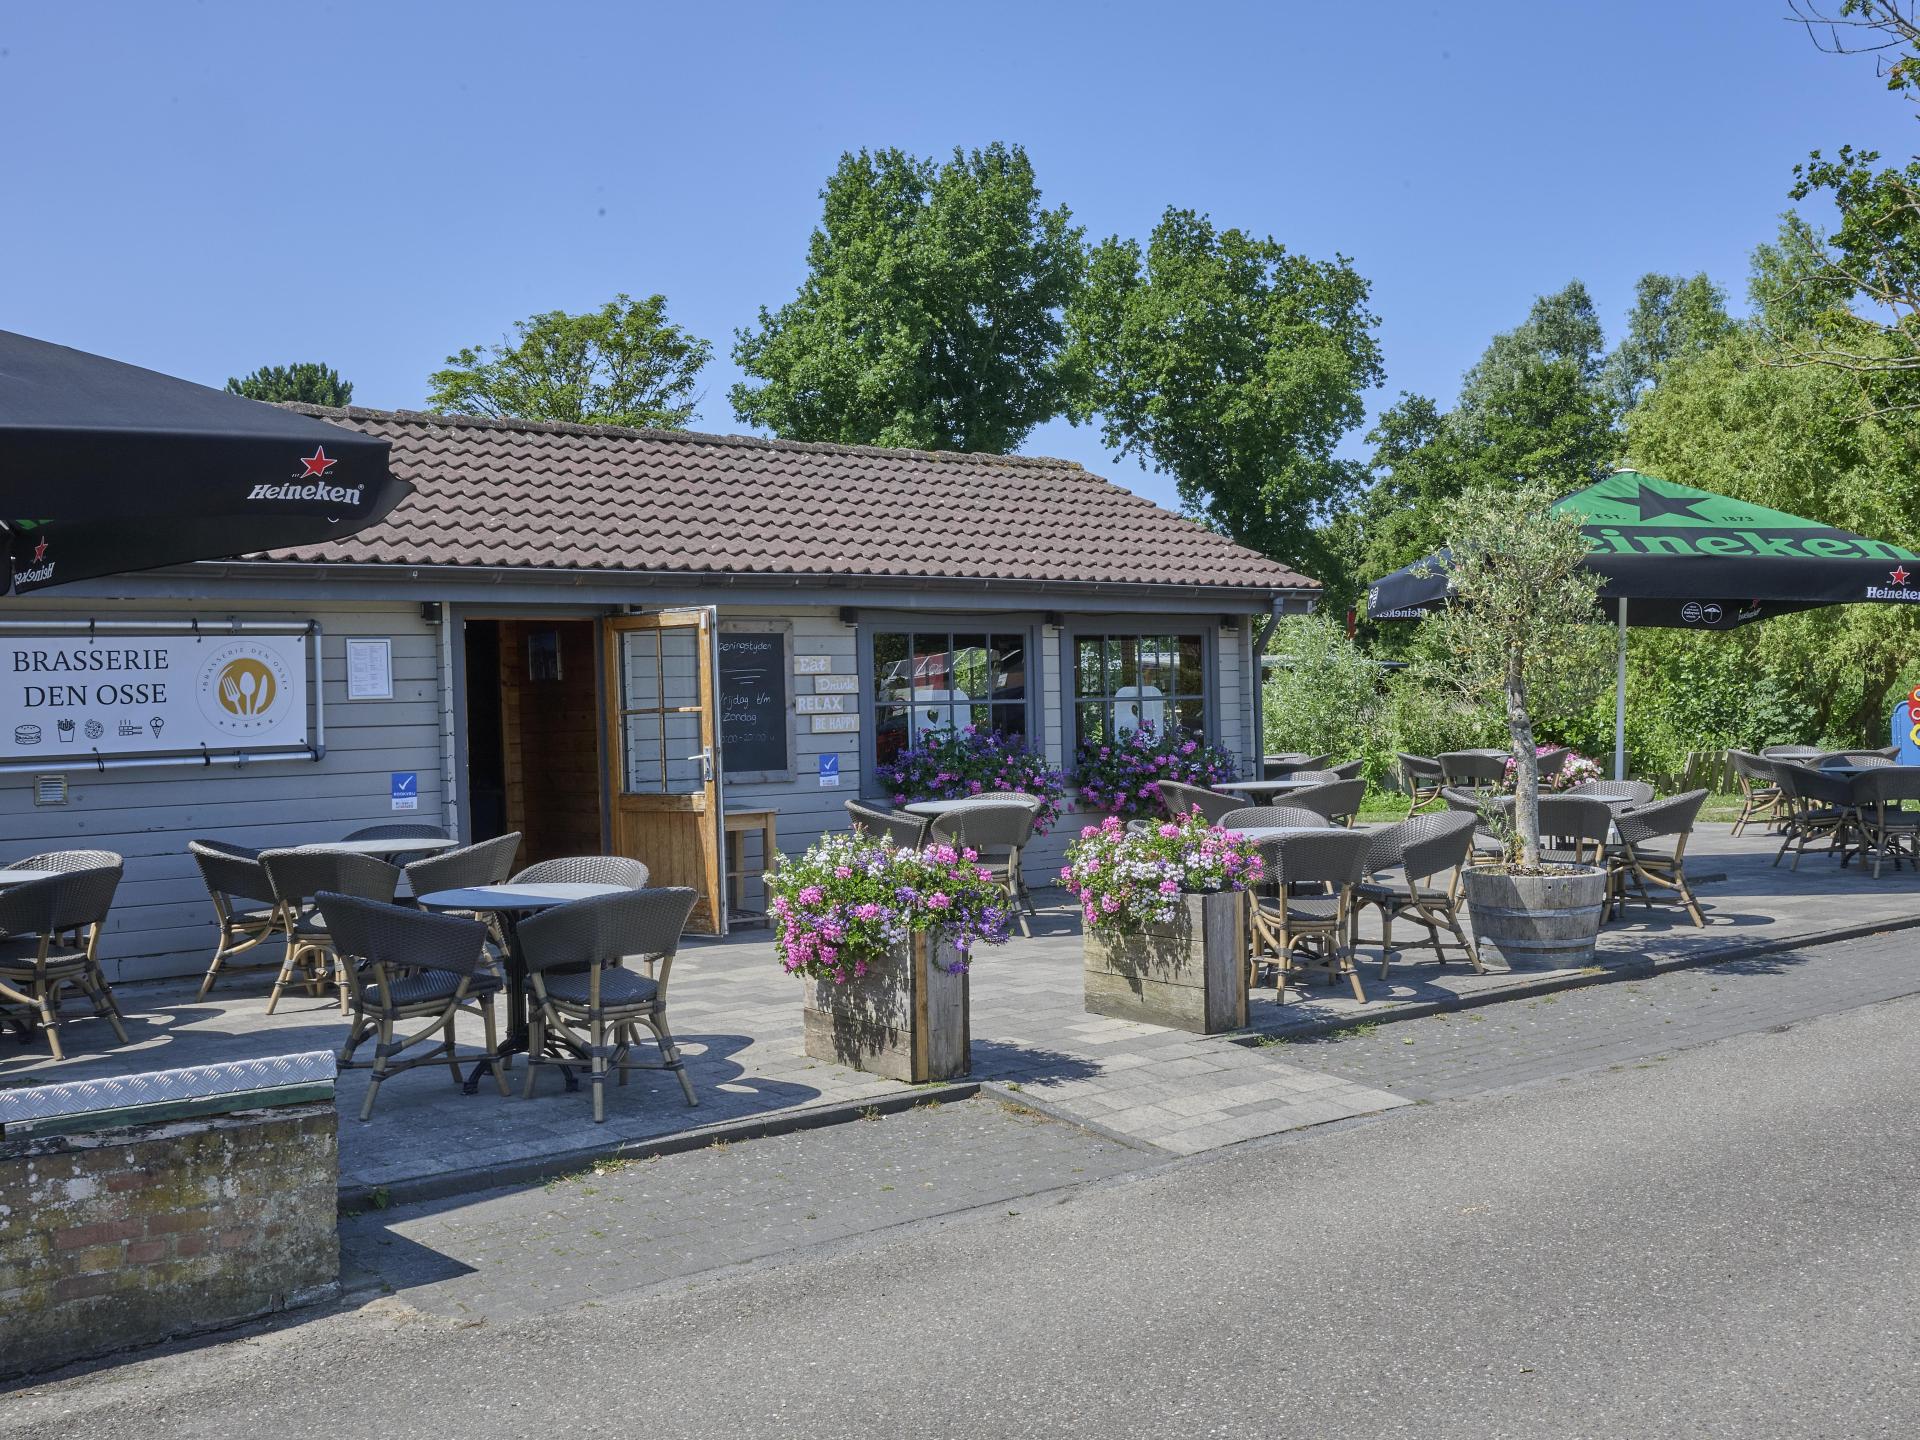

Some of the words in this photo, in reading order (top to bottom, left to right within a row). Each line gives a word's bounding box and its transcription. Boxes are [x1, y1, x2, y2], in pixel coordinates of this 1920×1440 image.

[246, 481, 360, 505] Heineken
[1580, 528, 1920, 560] eineken
[1866, 586, 1920, 600] Heineke
[12, 649, 169, 672] BRASSERIE
[799, 658, 826, 672] Eat
[23, 685, 88, 707] DEN
[96, 683, 167, 705] OSSE
[798, 696, 841, 711] RELAX
[815, 718, 828, 730] BE
[829, 716, 855, 730] HAPPY
